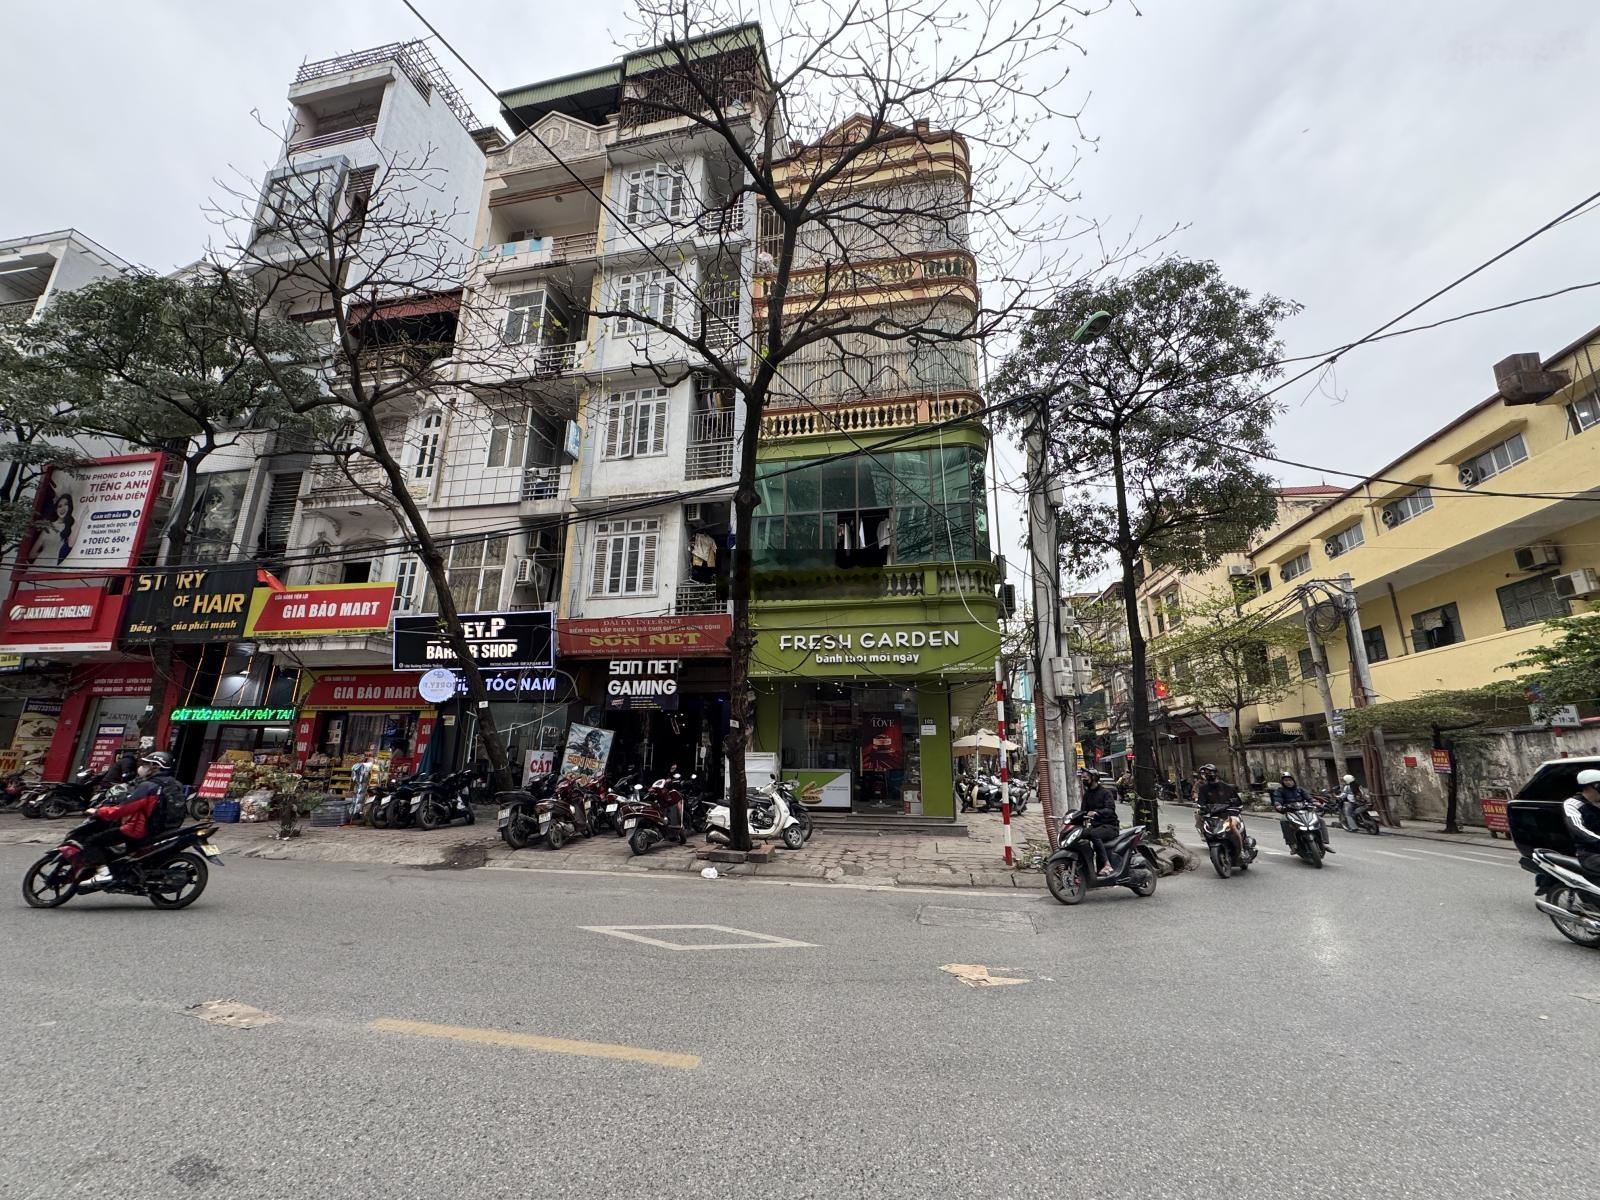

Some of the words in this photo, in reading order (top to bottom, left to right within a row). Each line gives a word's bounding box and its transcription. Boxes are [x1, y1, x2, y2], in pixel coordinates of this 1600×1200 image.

[92, 472, 118, 480] PHONG
[90, 479, 121, 492] TIẾNG
[124, 480, 149, 489] ANH
[173, 595, 190, 607] OF
[193, 593, 245, 614] HAIR
[282, 604, 306, 619] GIA
[309, 600, 337, 618] BẢO
[340, 601, 380, 616] MART
[24, 606, 56, 619] JAXTINA
[58, 605, 93, 618] ENGLISH
[171, 622, 188, 631] của
[649, 633, 701, 645] NET
[780, 634, 852, 650] FRESH
[860, 630, 959, 648] GARDEN
[426, 644, 479, 659] BARR
[481, 643, 518, 658] SHOP
[815, 652, 842, 664] bánh
[647, 660, 678, 674] NET
[485, 673, 517, 691] TÓC
[520, 678, 556, 690] NAM
[608, 679, 677, 695] GAMING
[334, 687, 353, 699] GIA
[357, 684, 381, 699] BẢO
[384, 687, 419, 698] MART
